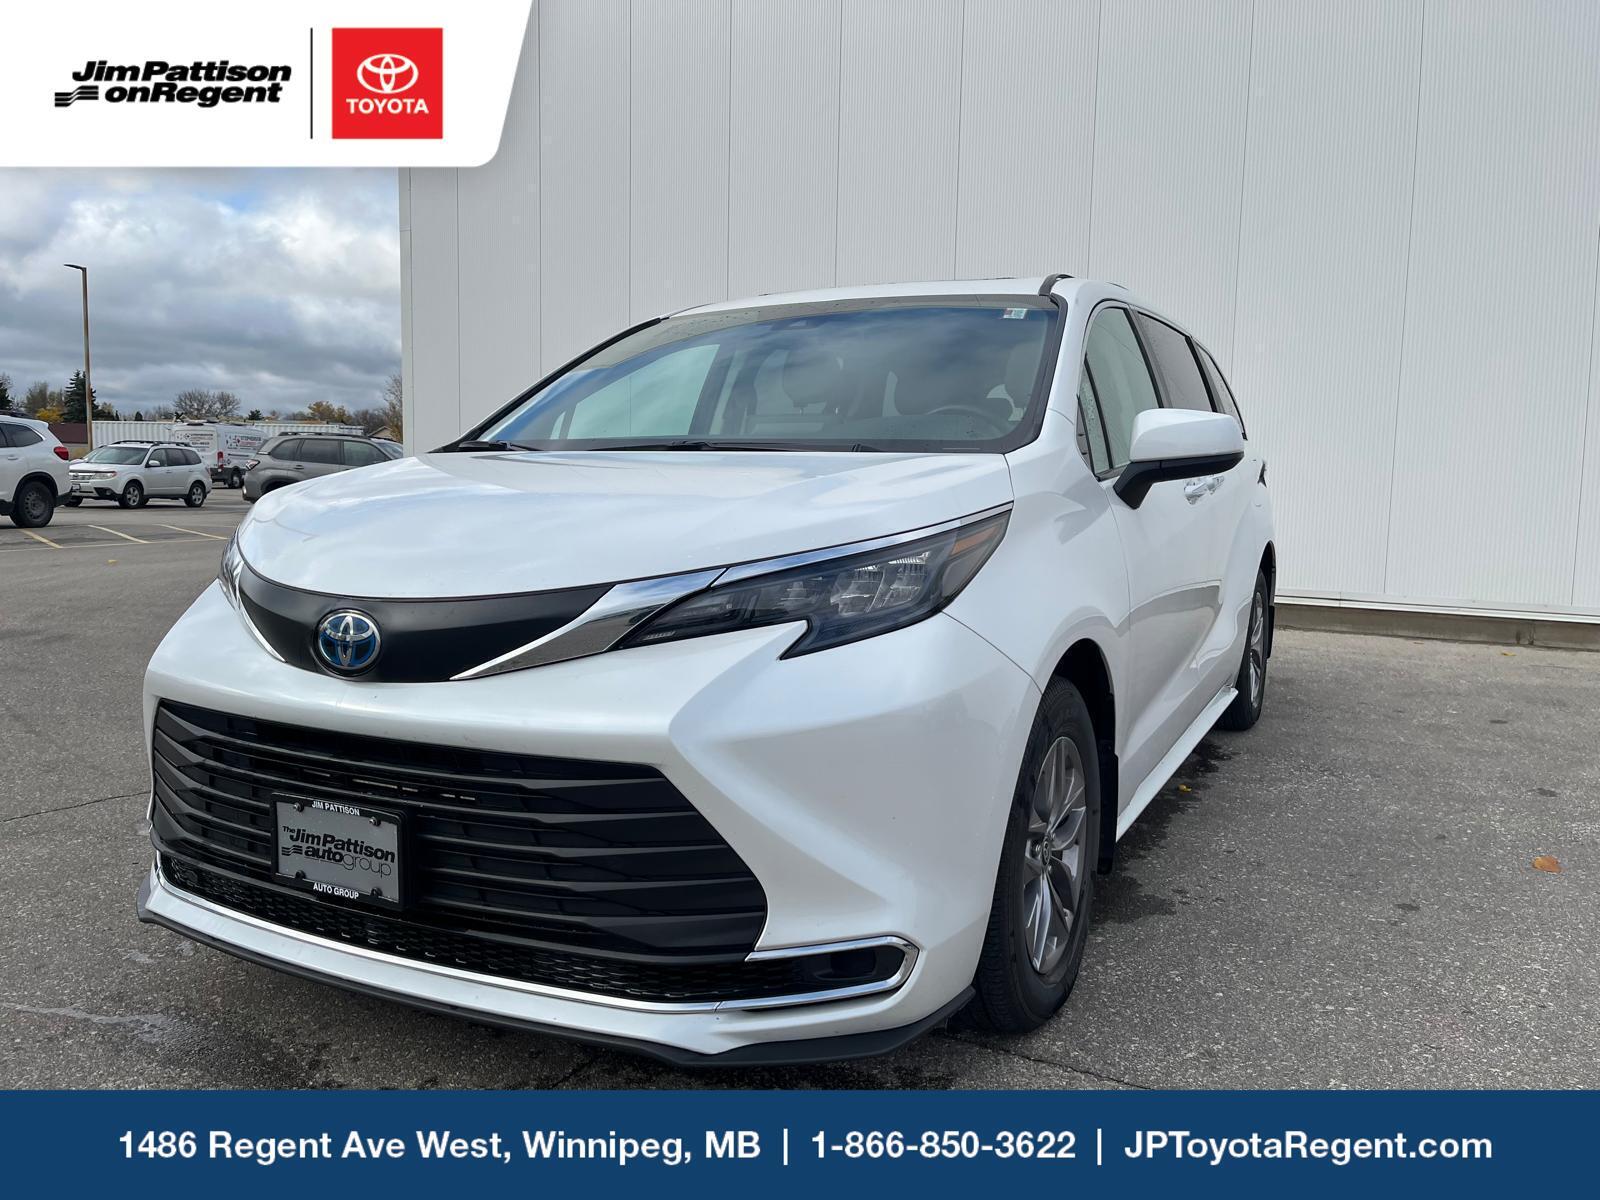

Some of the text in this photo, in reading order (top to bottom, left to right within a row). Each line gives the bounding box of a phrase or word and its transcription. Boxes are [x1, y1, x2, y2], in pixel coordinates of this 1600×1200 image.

[311, 800, 360, 816] JIM PATTISON
[282, 825, 296, 834] The
[313, 882, 360, 900] AUTO GROUP
